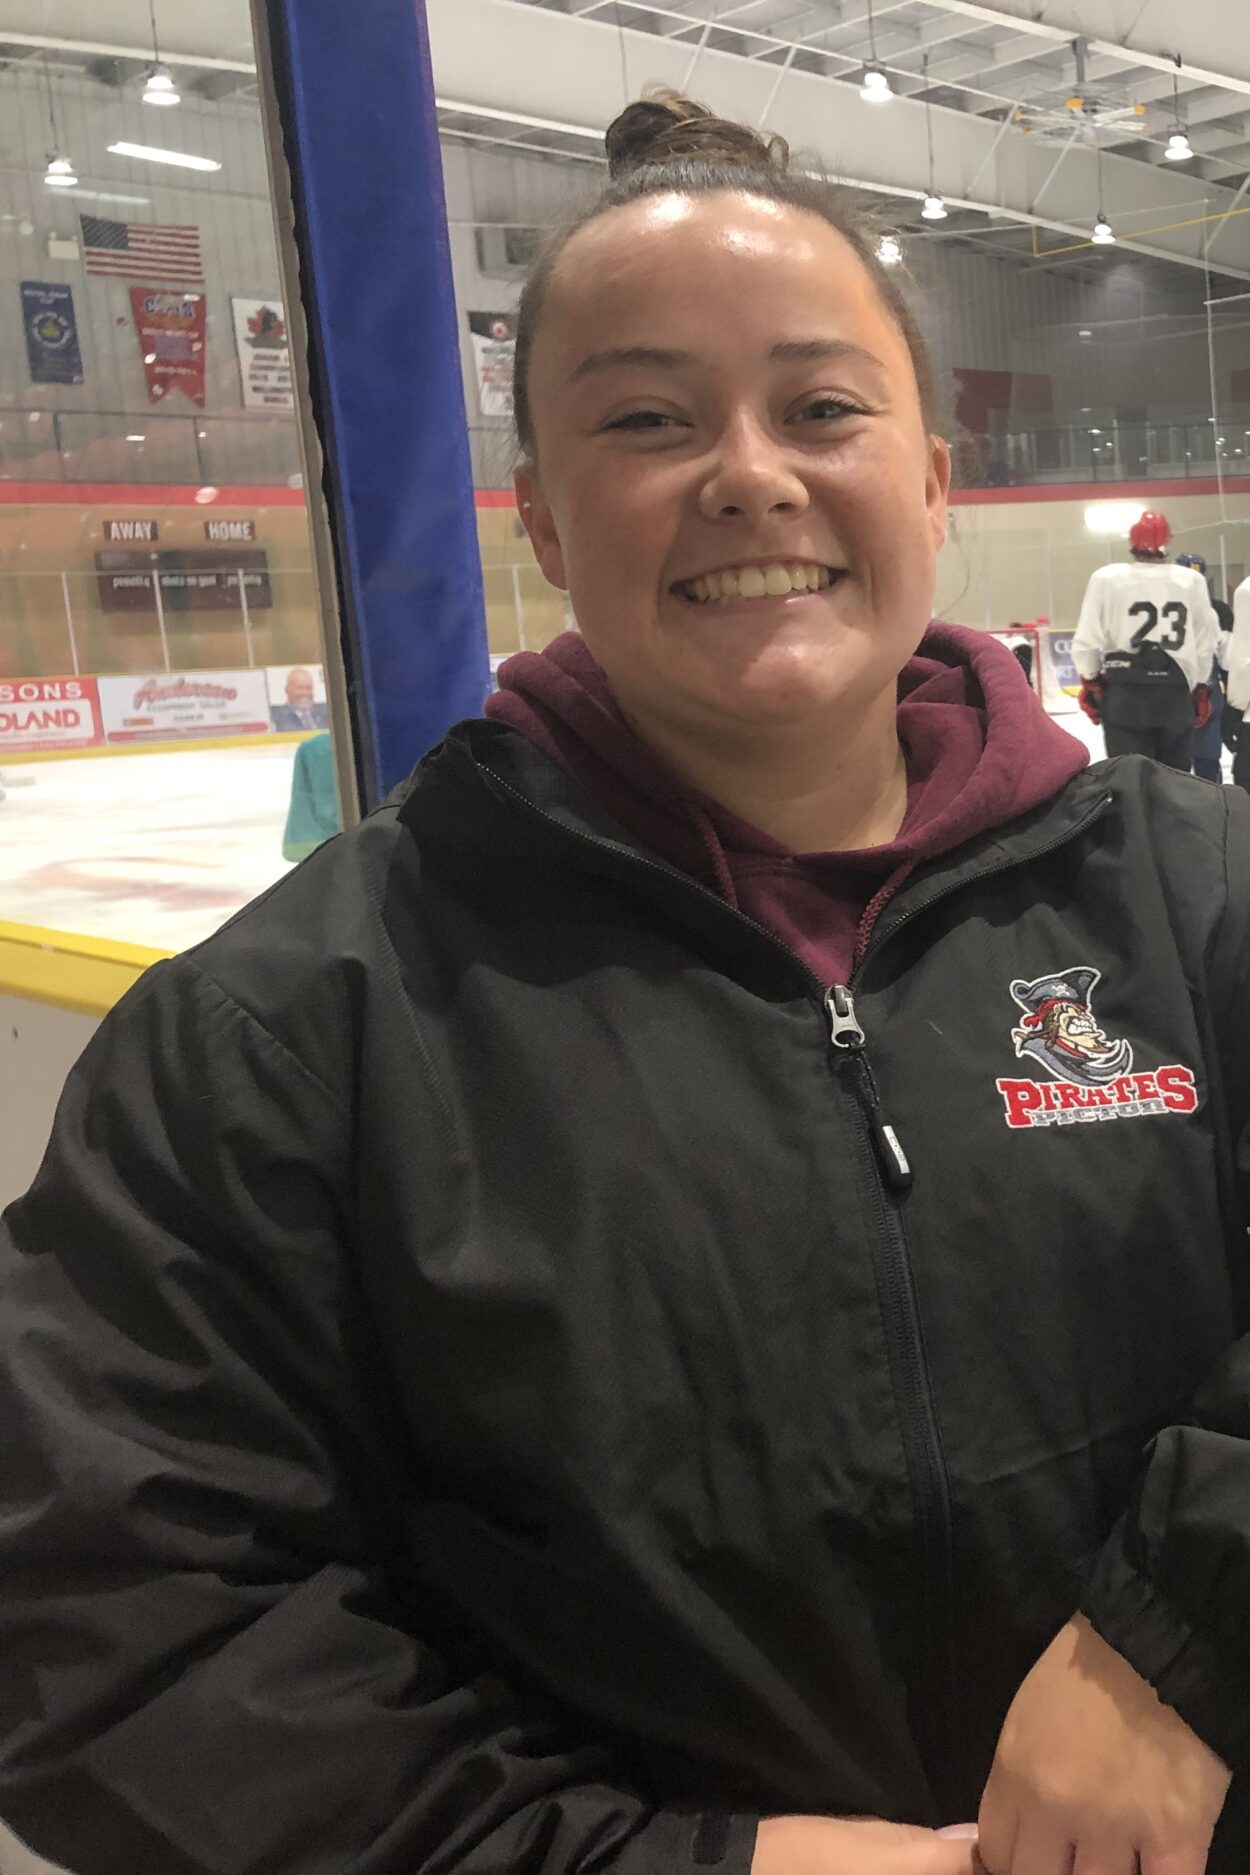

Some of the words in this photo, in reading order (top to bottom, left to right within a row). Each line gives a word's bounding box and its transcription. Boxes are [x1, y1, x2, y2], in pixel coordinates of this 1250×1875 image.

[110, 521, 152, 541] AWAY
[208, 521, 252, 541] HOME
[1128, 601, 1188, 651] 23
[996, 1064, 1199, 1128] PIRATES
[1022, 1098, 1169, 1127] PICTON
